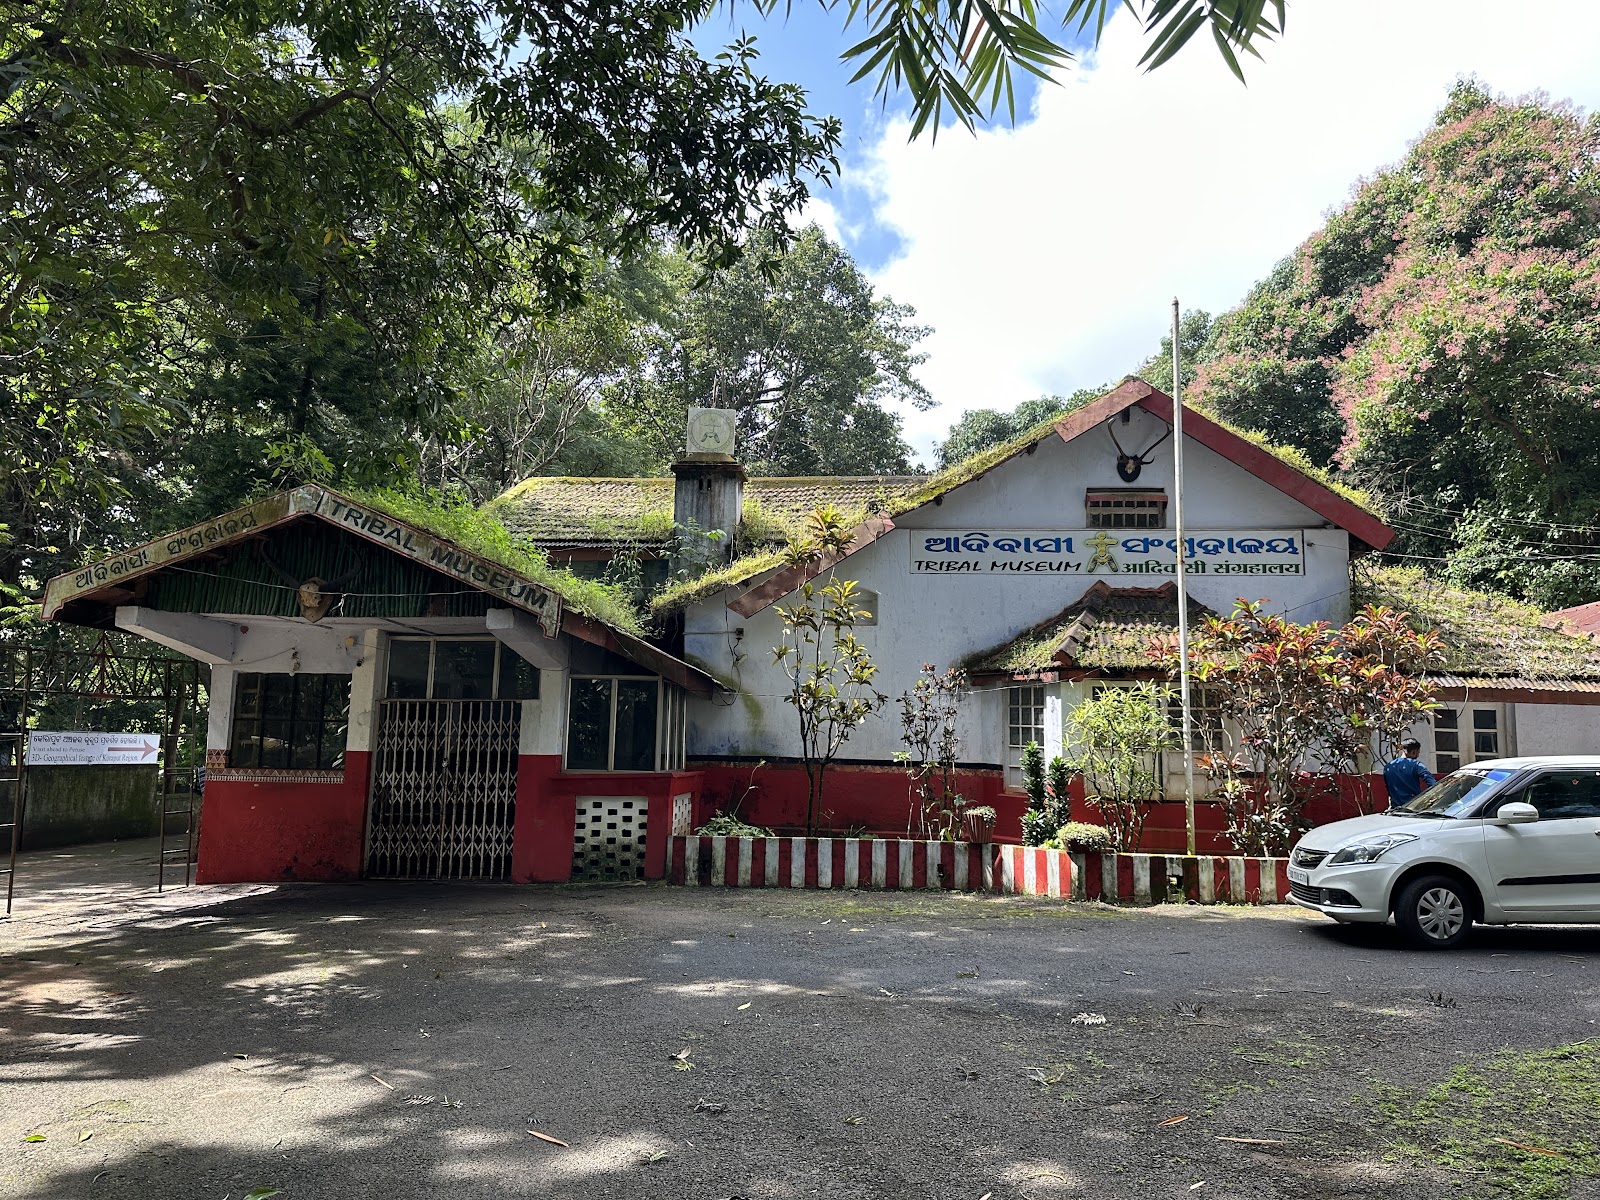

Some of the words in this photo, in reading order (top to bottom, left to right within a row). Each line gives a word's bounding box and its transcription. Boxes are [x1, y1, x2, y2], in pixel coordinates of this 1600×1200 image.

[924, 532, 1075, 554] ଆଦିବାସୀ
[330, 499, 417, 553] TRIBAL
[430, 545, 549, 609] MUSEUM
[75, 549, 149, 588] ଆଦିବାସୀ
[914, 560, 982, 572] TRIBAL
[990, 560, 1082, 573] MUSEUM
[1121, 560, 1207, 574] आदिवसी
[1212, 560, 1301, 575] संग्रहालय
[43, 753, 78, 764] Geographical
[95, 753, 102, 762] of
[102, 754, 121, 764] Koraput
